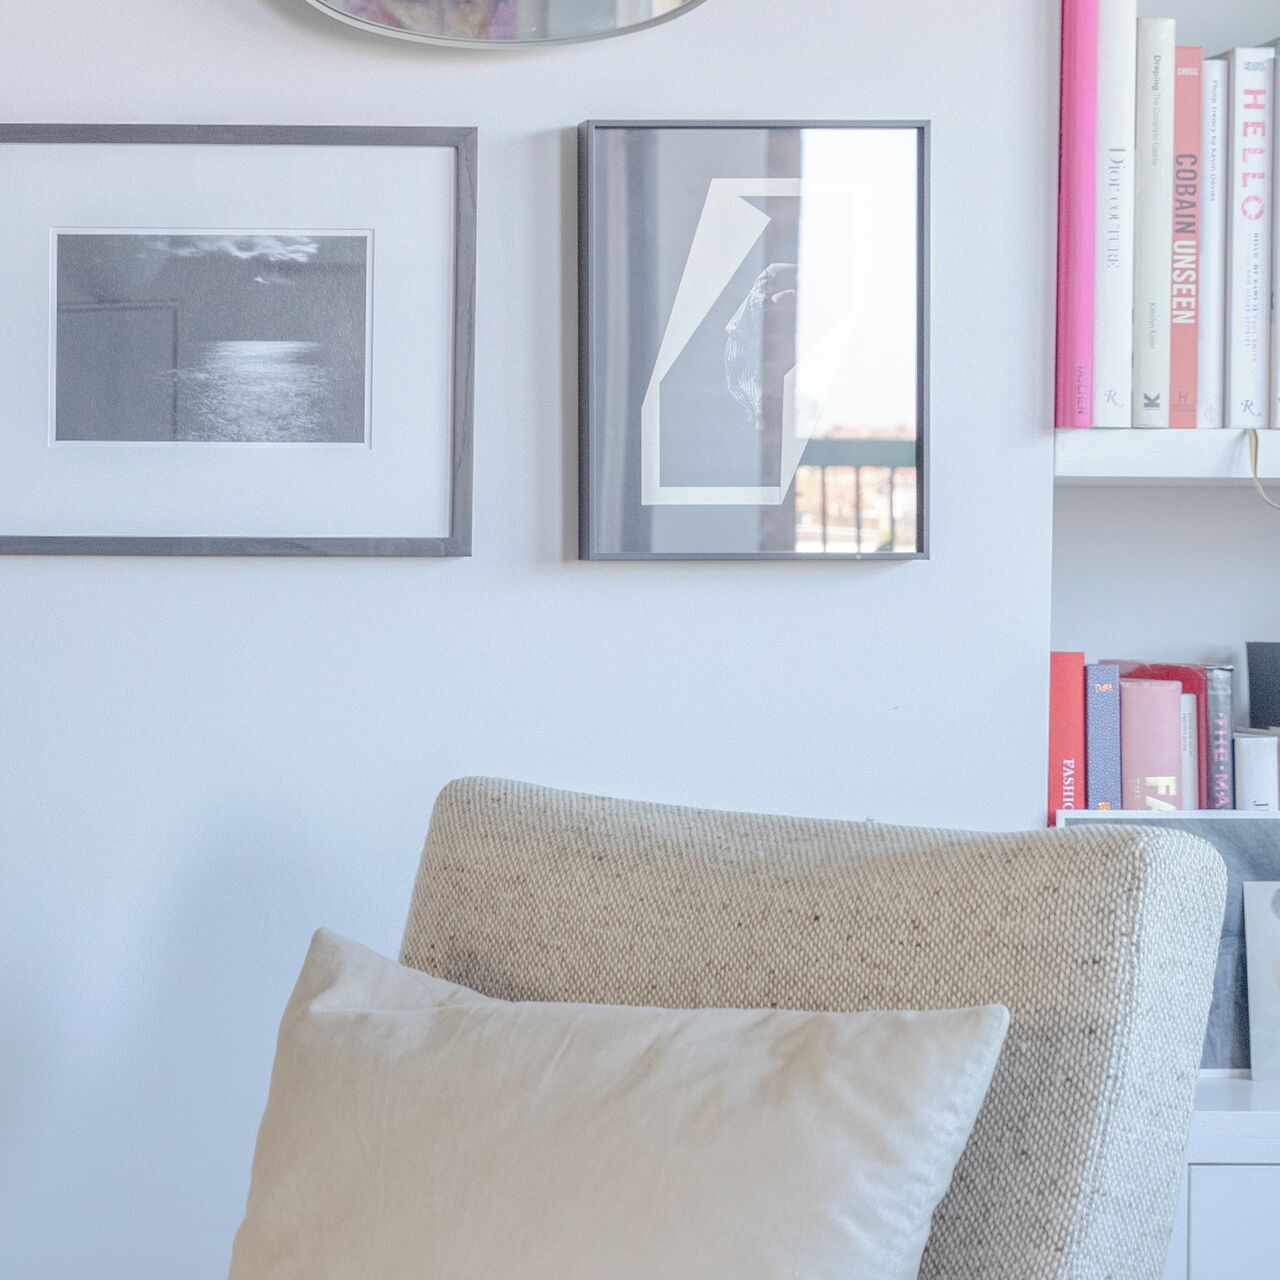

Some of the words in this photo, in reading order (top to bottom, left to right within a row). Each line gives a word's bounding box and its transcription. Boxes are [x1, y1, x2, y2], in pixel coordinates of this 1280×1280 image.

[1150, 55, 1162, 91] Draping
[1174, 153, 1198, 234] COBAIN
[1241, 88, 1267, 220] HELLO
[1172, 239, 1198, 324] UNSEEN
